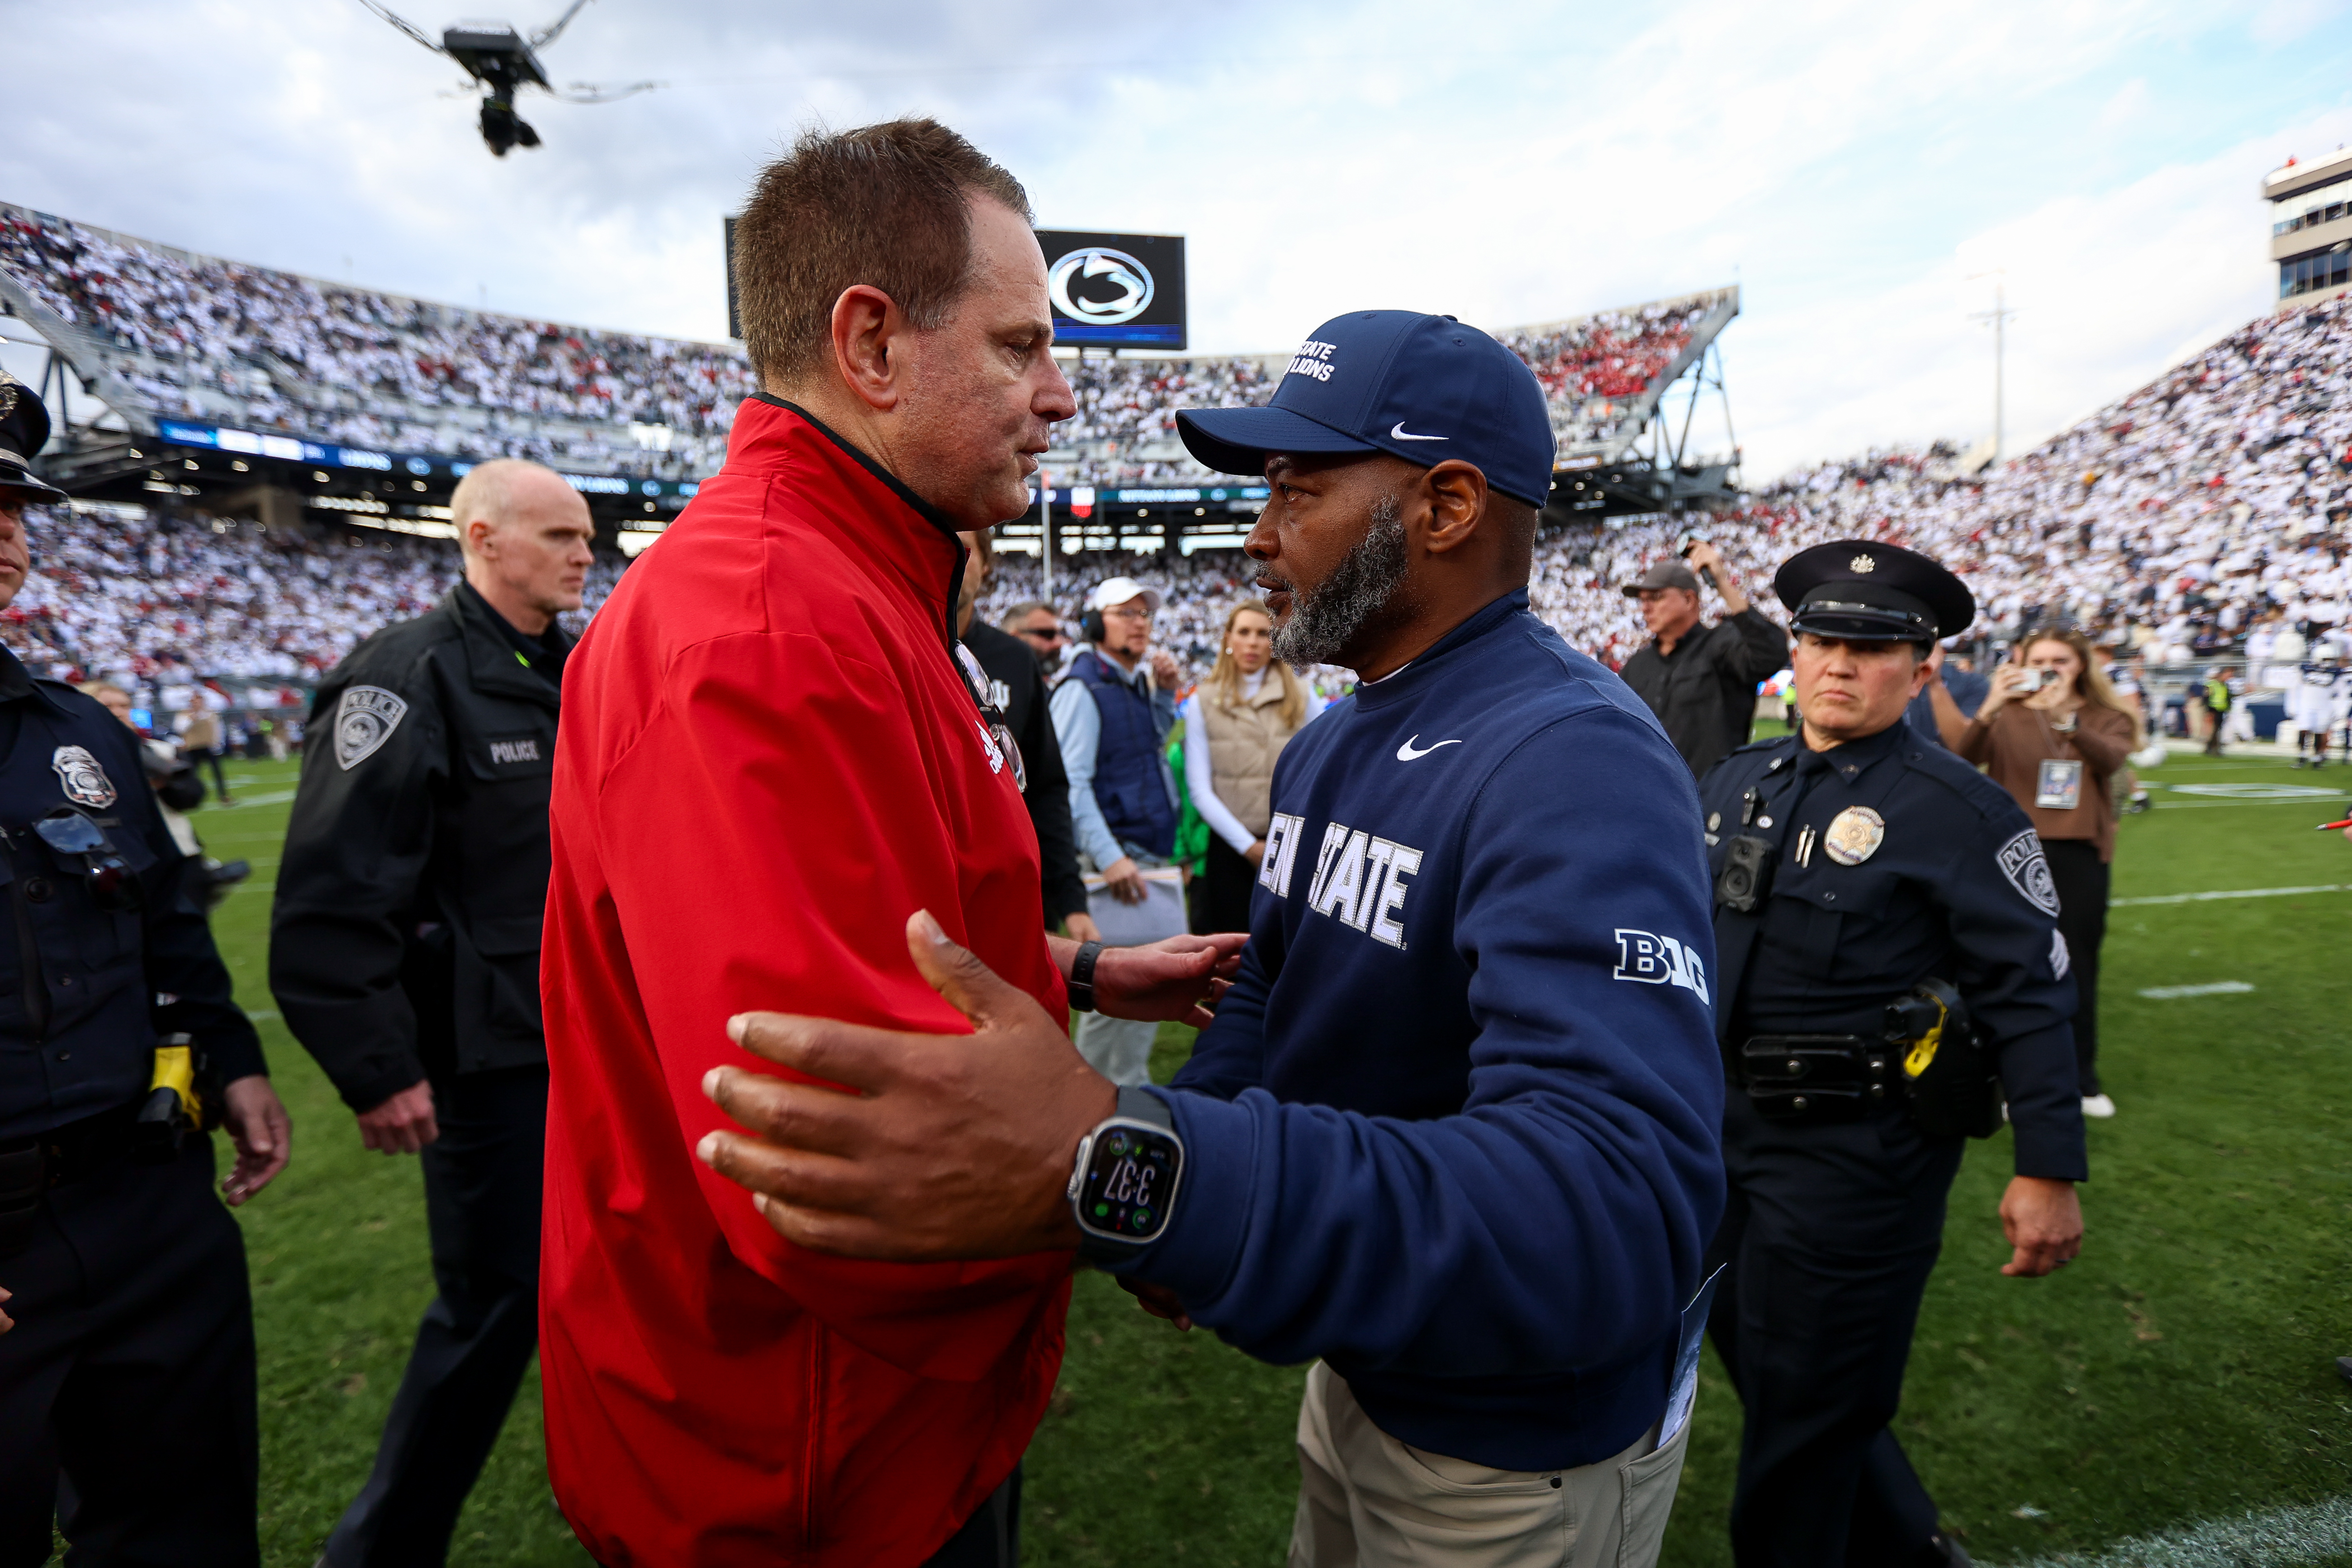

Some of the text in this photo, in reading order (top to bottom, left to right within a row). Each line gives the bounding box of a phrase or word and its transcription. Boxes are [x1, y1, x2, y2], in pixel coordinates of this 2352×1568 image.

[1289, 357, 1335, 382] LIONS
[346, 690, 403, 721] POLICE
[490, 740, 540, 764] POLICE
[1308, 821, 1424, 949] STATE
[1104, 1159, 1156, 1206] 3:37
